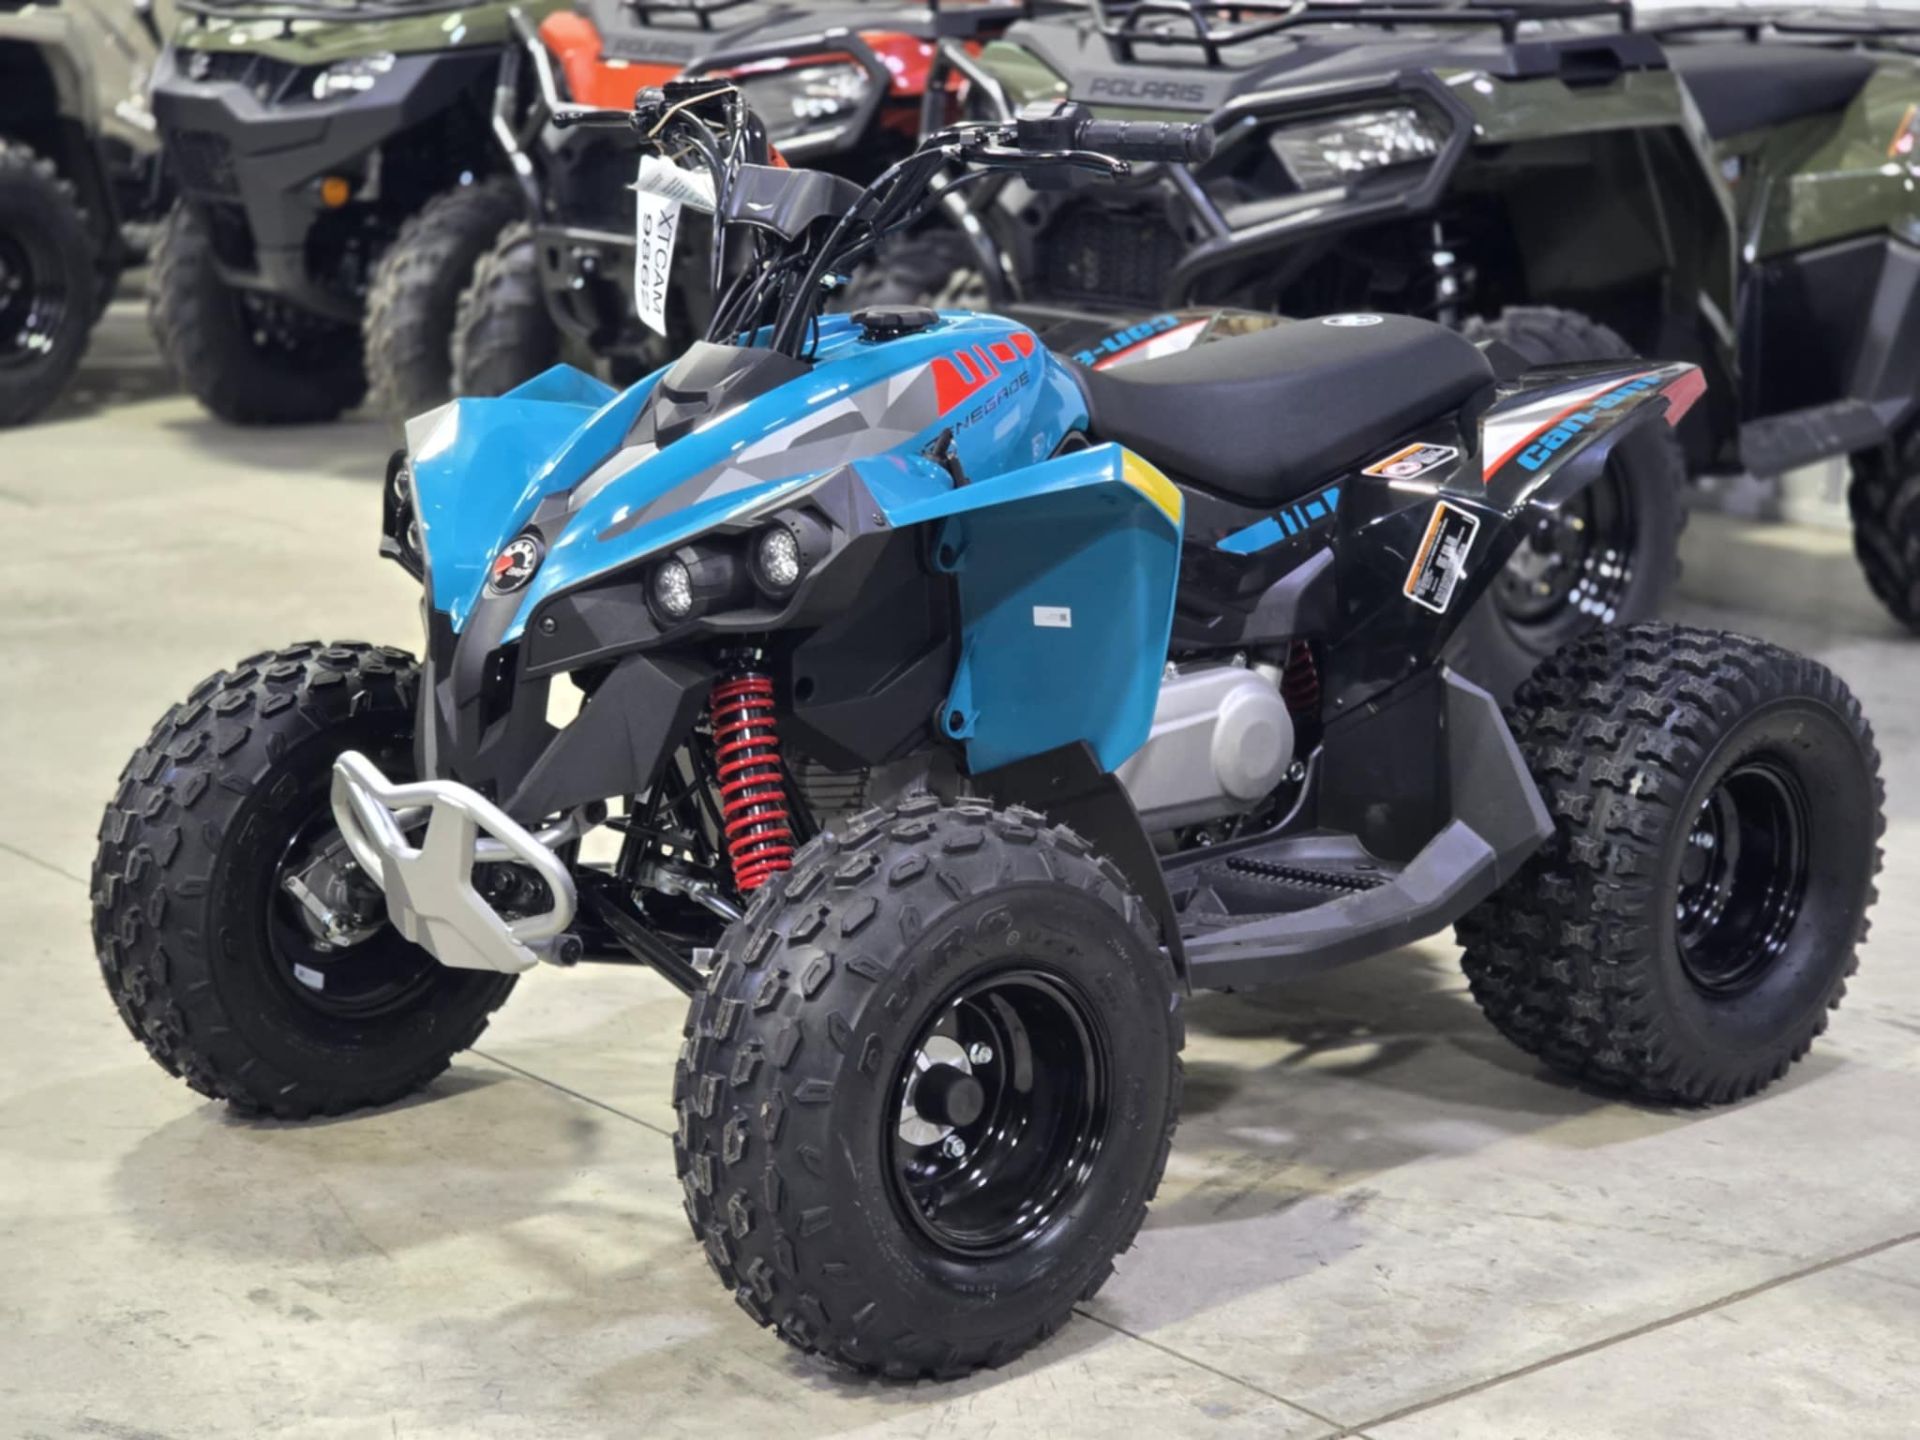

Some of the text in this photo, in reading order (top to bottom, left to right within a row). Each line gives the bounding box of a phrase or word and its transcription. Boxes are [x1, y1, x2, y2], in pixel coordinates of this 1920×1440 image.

[1088, 77, 1207, 102] POLARIS
[652, 208, 675, 315] XTCAM
[1072, 313, 1181, 367] can-a
